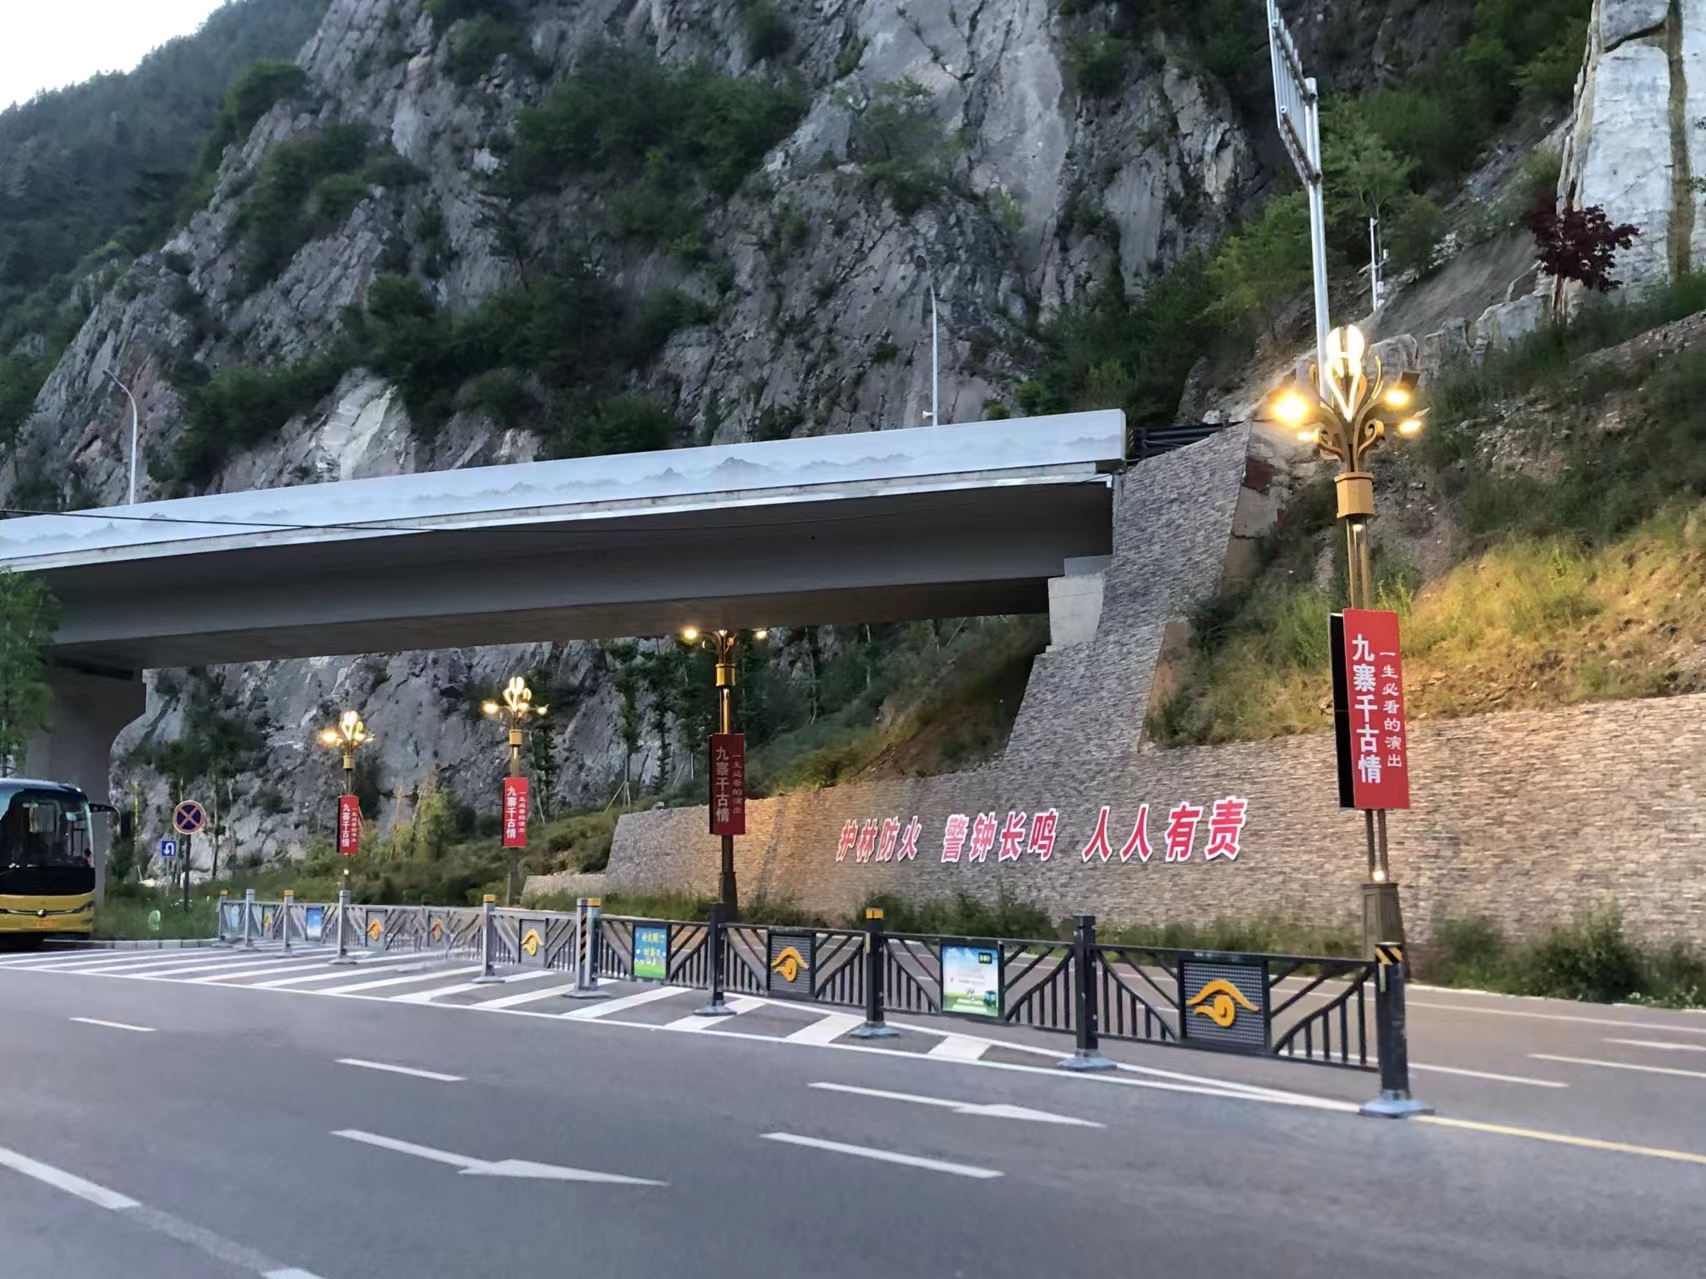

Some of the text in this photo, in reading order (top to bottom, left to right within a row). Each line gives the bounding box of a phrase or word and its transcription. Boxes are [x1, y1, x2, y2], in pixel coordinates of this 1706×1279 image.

[1351, 633, 1382, 784] 九寨千古情
[1379, 651, 1402, 768] 一生必看的演出
[716, 746, 730, 823] 九寨千古情
[835, 794, 1248, 863] 护林防火 警钟长鸣 人人有责
